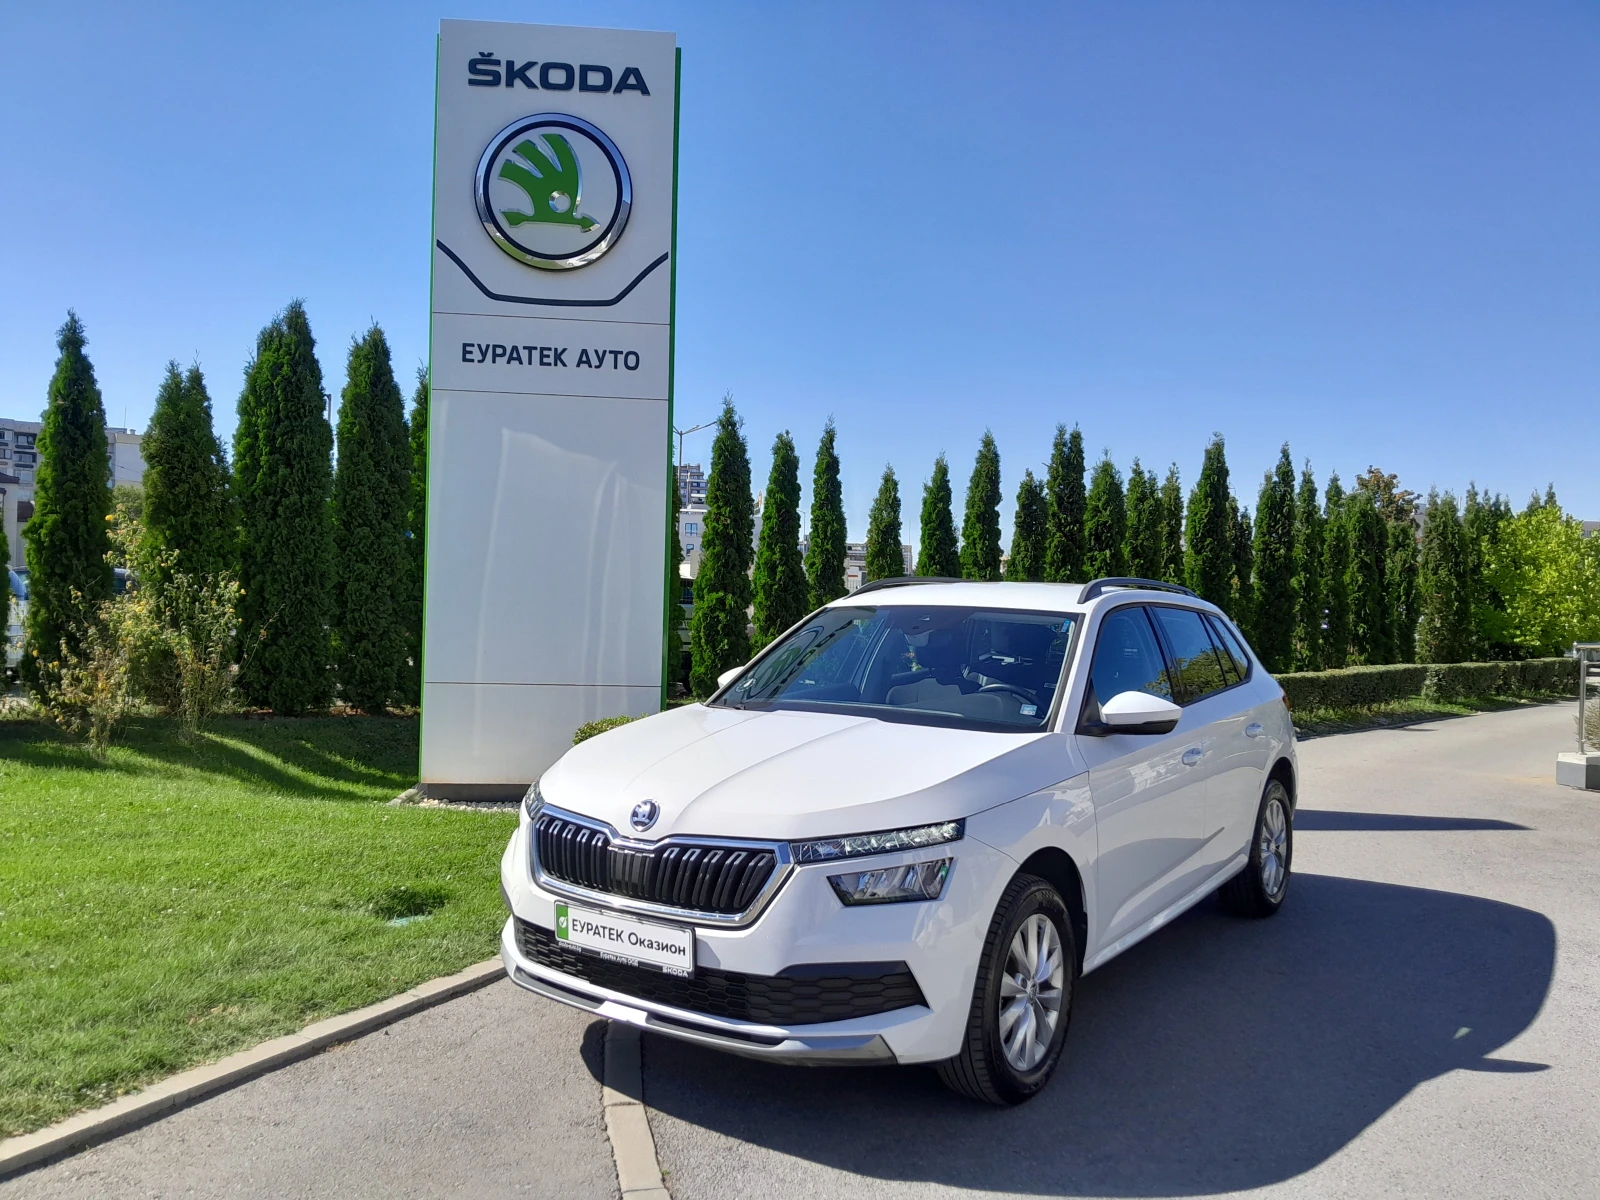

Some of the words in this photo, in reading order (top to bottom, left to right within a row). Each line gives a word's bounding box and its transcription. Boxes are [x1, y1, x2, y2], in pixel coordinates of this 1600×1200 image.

[467, 52, 651, 96] ŠKODA
[461, 342, 569, 368] ЕУРАТЕК
[575, 348, 641, 371] АУТО
[572, 919, 625, 943] ЕУРАТЕК
[628, 932, 686, 956] Оказион
